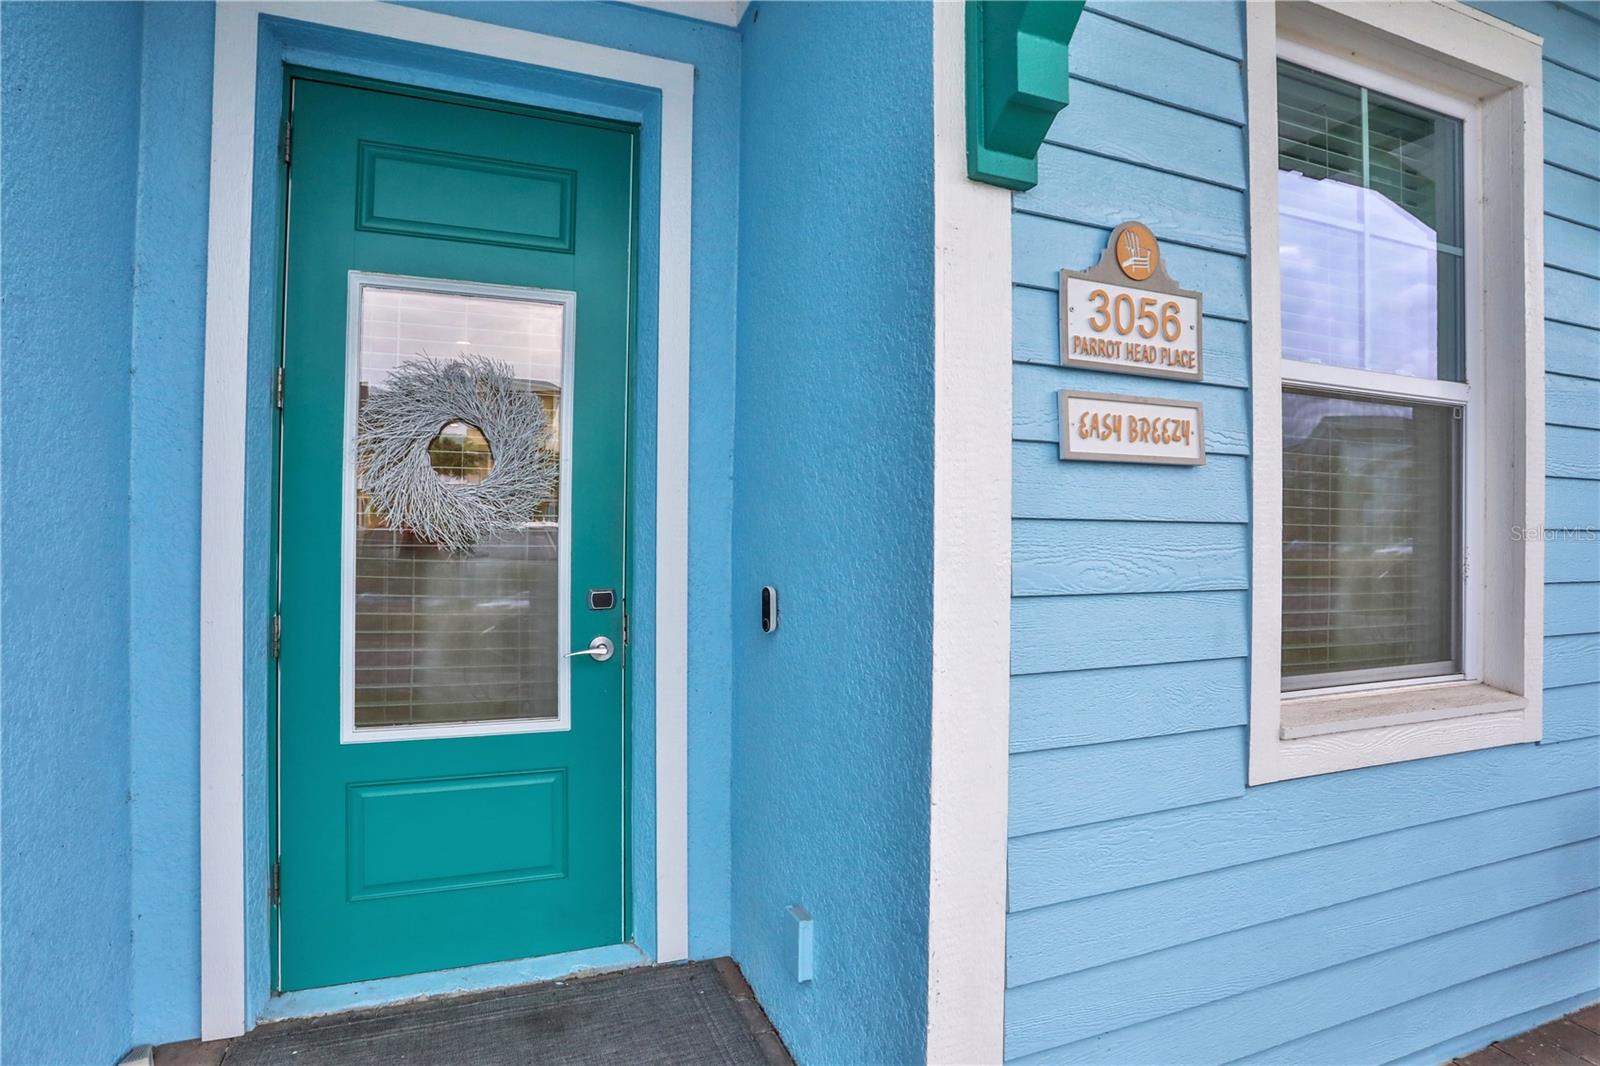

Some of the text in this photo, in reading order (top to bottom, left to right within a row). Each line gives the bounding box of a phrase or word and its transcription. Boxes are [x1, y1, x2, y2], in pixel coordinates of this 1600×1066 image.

[1088, 288, 1182, 342] 3056
[1073, 335, 1196, 369] PARROT HEAD PLACE
[1078, 411, 1191, 446] EASY BREEZY
